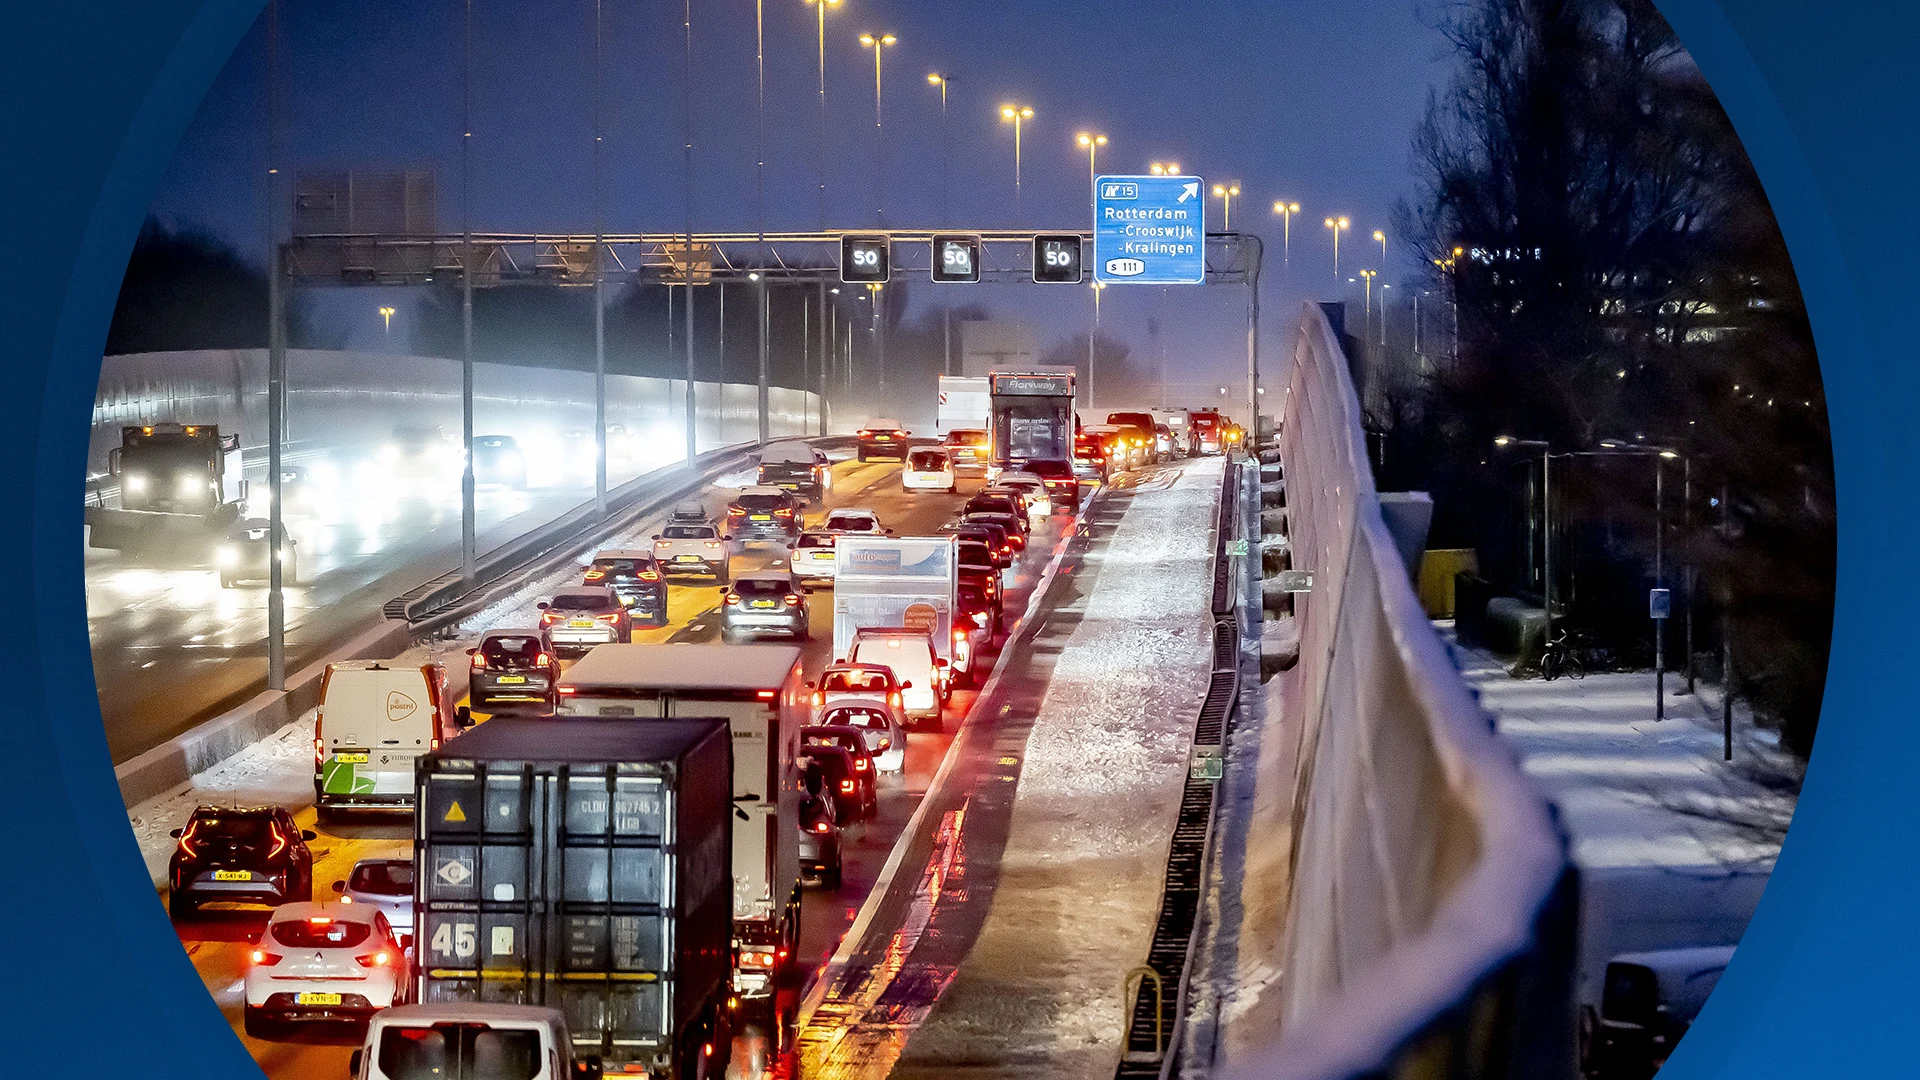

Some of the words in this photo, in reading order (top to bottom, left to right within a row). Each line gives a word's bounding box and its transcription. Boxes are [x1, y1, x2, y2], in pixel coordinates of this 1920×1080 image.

[1122, 186, 1134, 196] 15
[1105, 207, 1187, 219] Rotterdam
[1119, 225, 1193, 239] -Crooswijk
[1118, 242, 1193, 257] -Kralingen
[853, 250, 878, 265] 50
[944, 250, 968, 265] 50
[1046, 251, 1070, 266] 50
[1123, 262, 1137, 271] 111
[1009, 380, 1056, 391] Floriway
[431, 923, 475, 958] 45
